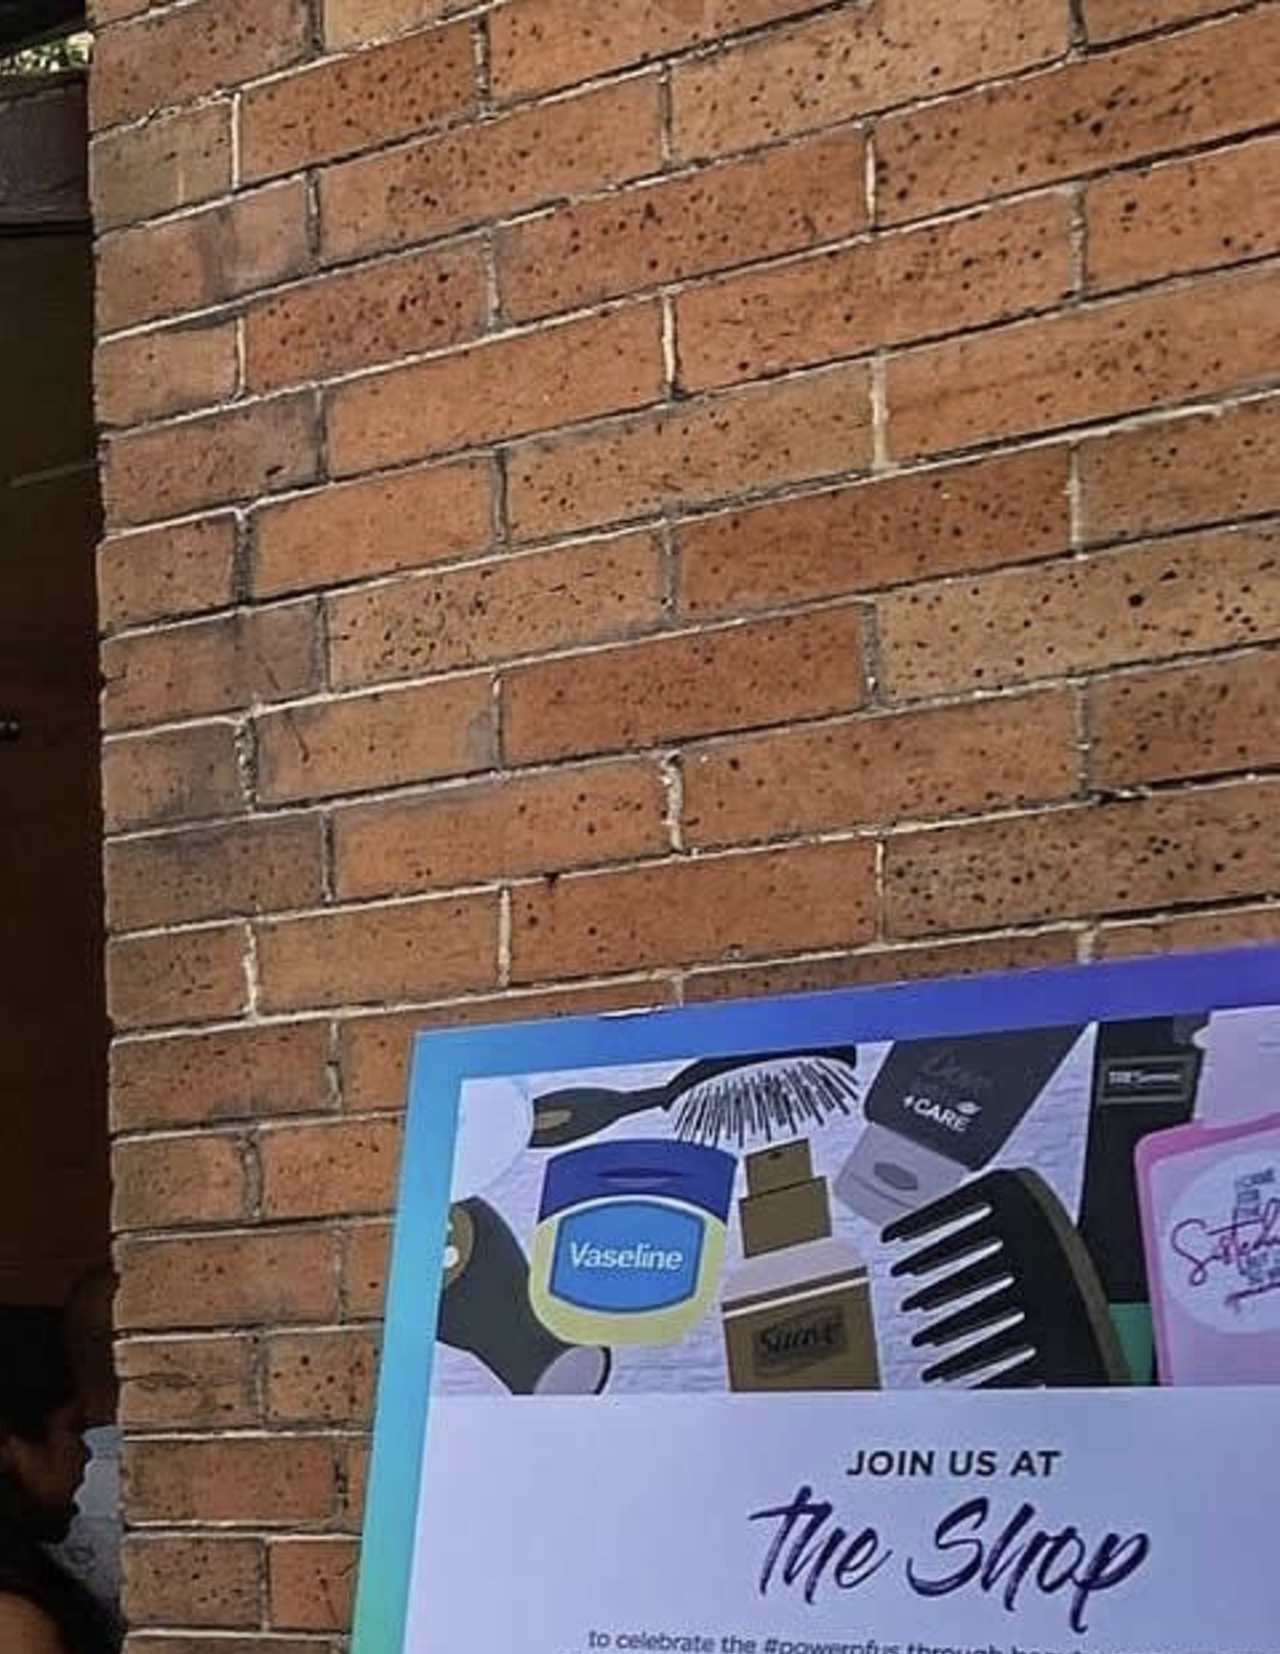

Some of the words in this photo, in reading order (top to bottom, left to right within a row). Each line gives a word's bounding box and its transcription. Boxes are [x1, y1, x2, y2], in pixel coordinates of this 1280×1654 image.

[570, 1240, 684, 1272] Vaseline
[845, 1449, 936, 1478] JOIN
[947, 1449, 999, 1478] US
[1009, 1449, 1062, 1479] AT
[905, 1496, 1151, 1635] Shop
[587, 1629, 613, 1650] to
